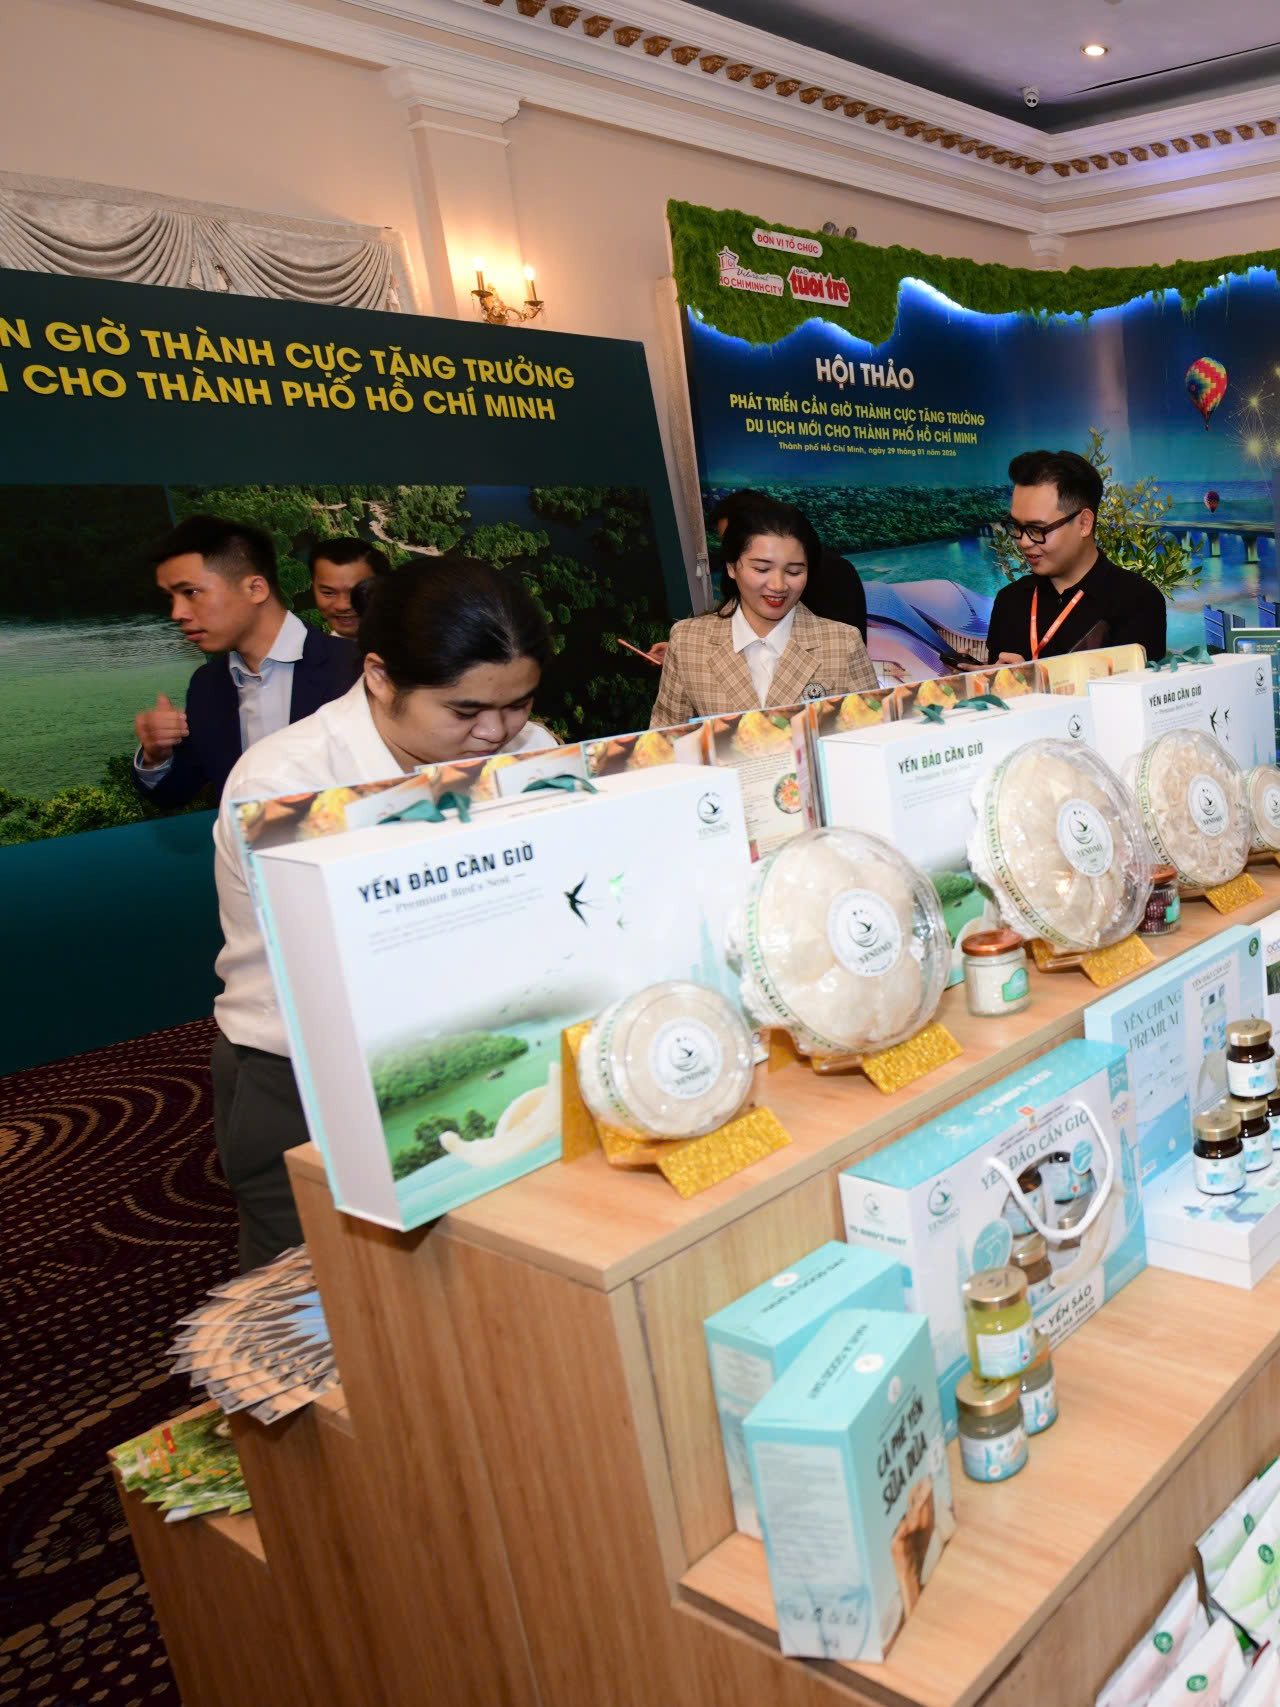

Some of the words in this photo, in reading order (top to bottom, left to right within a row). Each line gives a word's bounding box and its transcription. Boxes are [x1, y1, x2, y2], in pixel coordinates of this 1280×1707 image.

[757, 234, 774, 244] ĐƠN
[798, 241, 818, 254] CHỨC
[765, 284, 782, 295] CITY
[45, 317, 131, 356] GIỜ
[140, 326, 276, 367] THÀNH
[285, 342, 363, 378] CỰC
[370, 345, 456, 380] TĂNG
[463, 355, 575, 389] TRƯỞNG
[815, 354, 854, 390] HỘI
[860, 358, 915, 390] THẢO
[22, 364, 127, 398] CHO
[137, 367, 272, 405] THÀNH
[281, 374, 356, 409] PHỐ
[365, 377, 414, 414] HỒ
[424, 386, 478, 416] CHÍ
[485, 394, 556, 420] MINH
[729, 392, 762, 410] PHÁT
[765, 391, 799, 412] TRIỂN
[801, 394, 828, 416] CẦN
[831, 401, 853, 417] GIỜ
[855, 402, 891, 420] THÀNH
[894, 407, 917, 426] CỰC
[919, 407, 945, 424] TĂNG
[947, 408, 985, 426] TRƯỞNG
[746, 418, 764, 432] DU
[767, 420, 795, 437] LỊCH
[798, 418, 822, 437] MỚI
[825, 423, 851, 438] CHO
[853, 423, 890, 440] THÀNH
[892, 425, 915, 441] PHỐ
[917, 424, 931, 442] HỒ
[934, 428, 952, 443] CHÍ
[953, 432, 977, 444] MINH
[779, 441, 803, 451] Thành
[804, 442, 819, 451] phố
[833, 444, 845, 452] Chí
[868, 446, 885, 455] ngày
[898, 752, 918, 775] YẾN
[921, 750, 942, 768] ĐẢO
[944, 746, 964, 763] CẦN
[968, 739, 984, 757] GIỜ
[358, 875, 400, 903] YẾN
[409, 863, 448, 891] ĐẢO
[456, 854, 496, 879] CẦN
[503, 841, 534, 867] GIỜ
